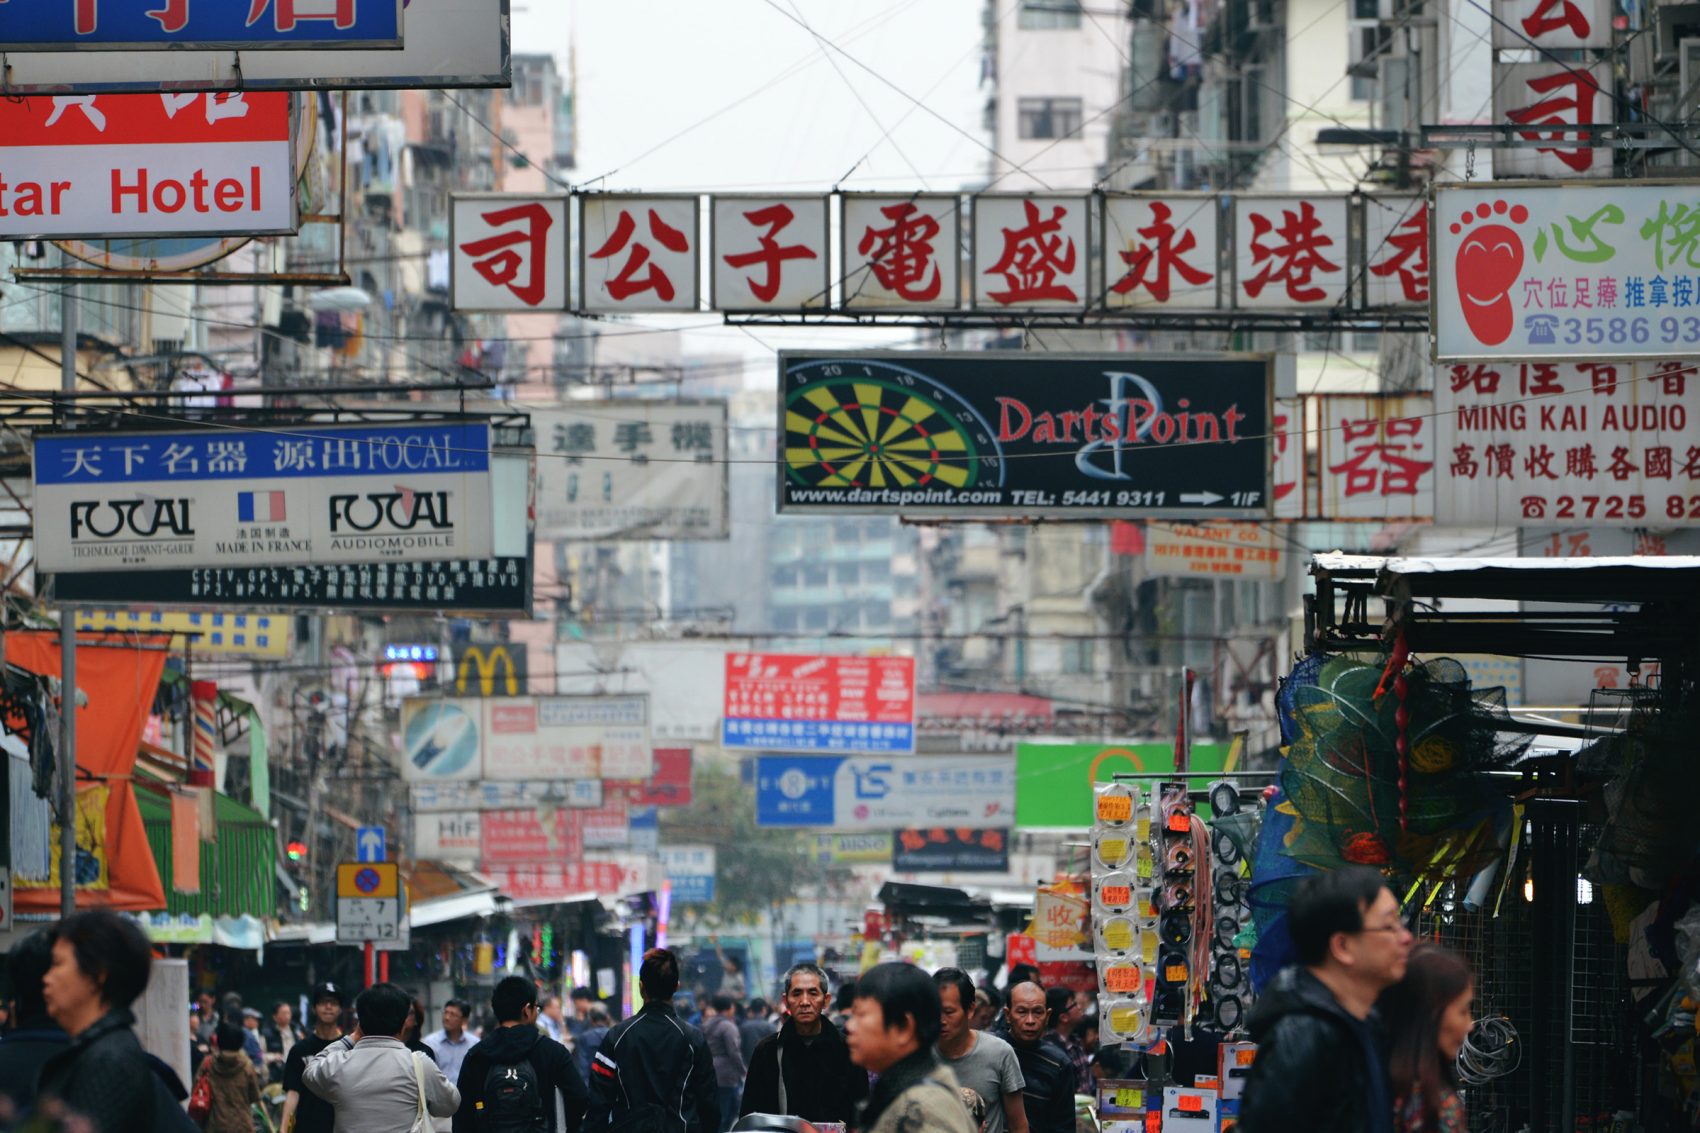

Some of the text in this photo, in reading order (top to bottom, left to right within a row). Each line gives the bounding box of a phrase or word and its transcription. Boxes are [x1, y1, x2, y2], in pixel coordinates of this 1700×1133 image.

[111, 166, 261, 214] Hotel
[1625, 274, 1700, 309] 推拿按
[1564, 317, 1650, 345] 3586
[1457, 404, 1687, 432] MING KAI AUDIO
[60, 440, 248, 478] 天下名器
[790, 488, 1002, 505] www.dartspoint.com
[1011, 490, 1054, 506] TEL:
[1062, 491, 1109, 506] 5441
[1116, 491, 1166, 506] 9311
[1556, 495, 1647, 519] 2725
[70, 498, 196, 539] FOCAL
[328, 491, 454, 532] FOCAL
[215, 538, 312, 554] MADE IN FRANCE
[330, 535, 454, 550] AUDIOMOBILE
[376, 900, 386, 914] 7
[377, 922, 394, 938] 12
